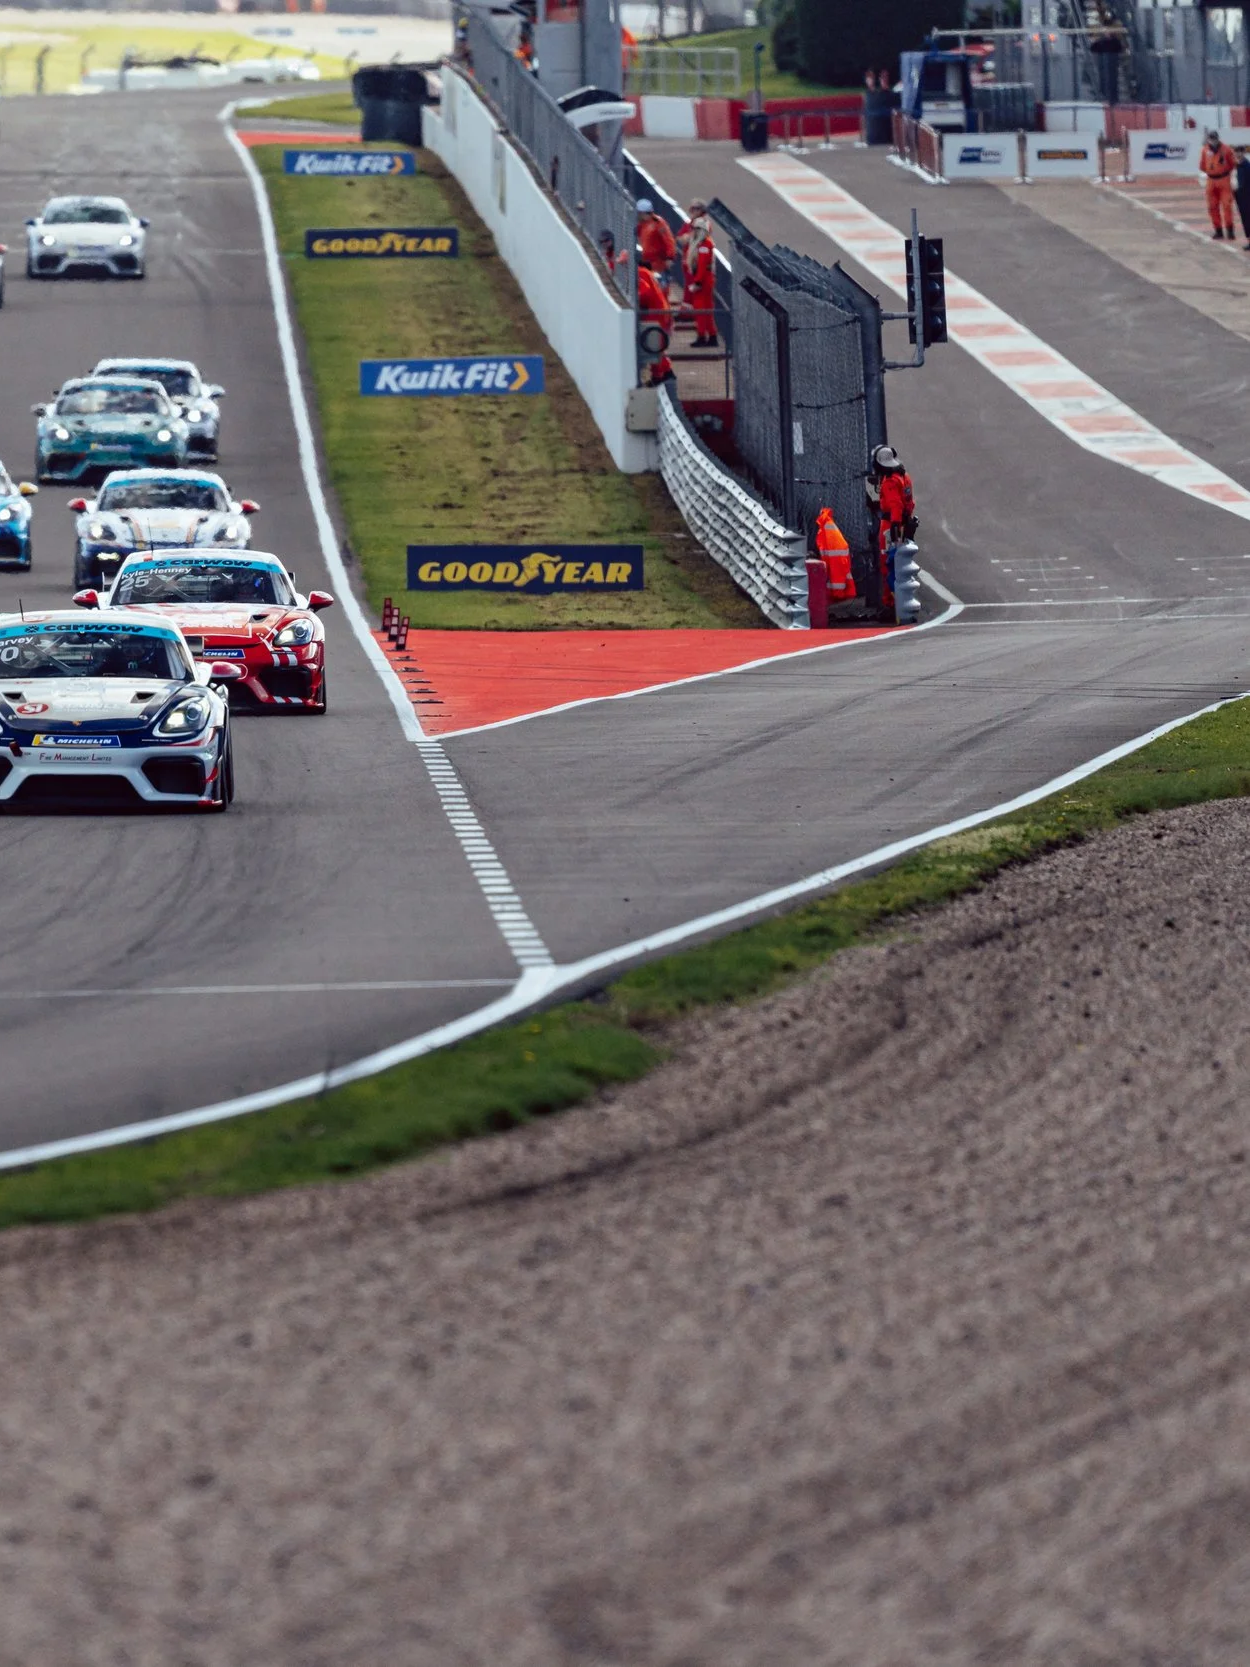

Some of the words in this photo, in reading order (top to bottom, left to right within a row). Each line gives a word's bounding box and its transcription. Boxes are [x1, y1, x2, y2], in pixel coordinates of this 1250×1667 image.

[170, 559, 252, 567] carwow
[121, 567, 192, 580] Kyle-Henney
[418, 557, 632, 585] GOODYEAR
[119, 575, 150, 592] 25
[44, 624, 143, 633] carwow
